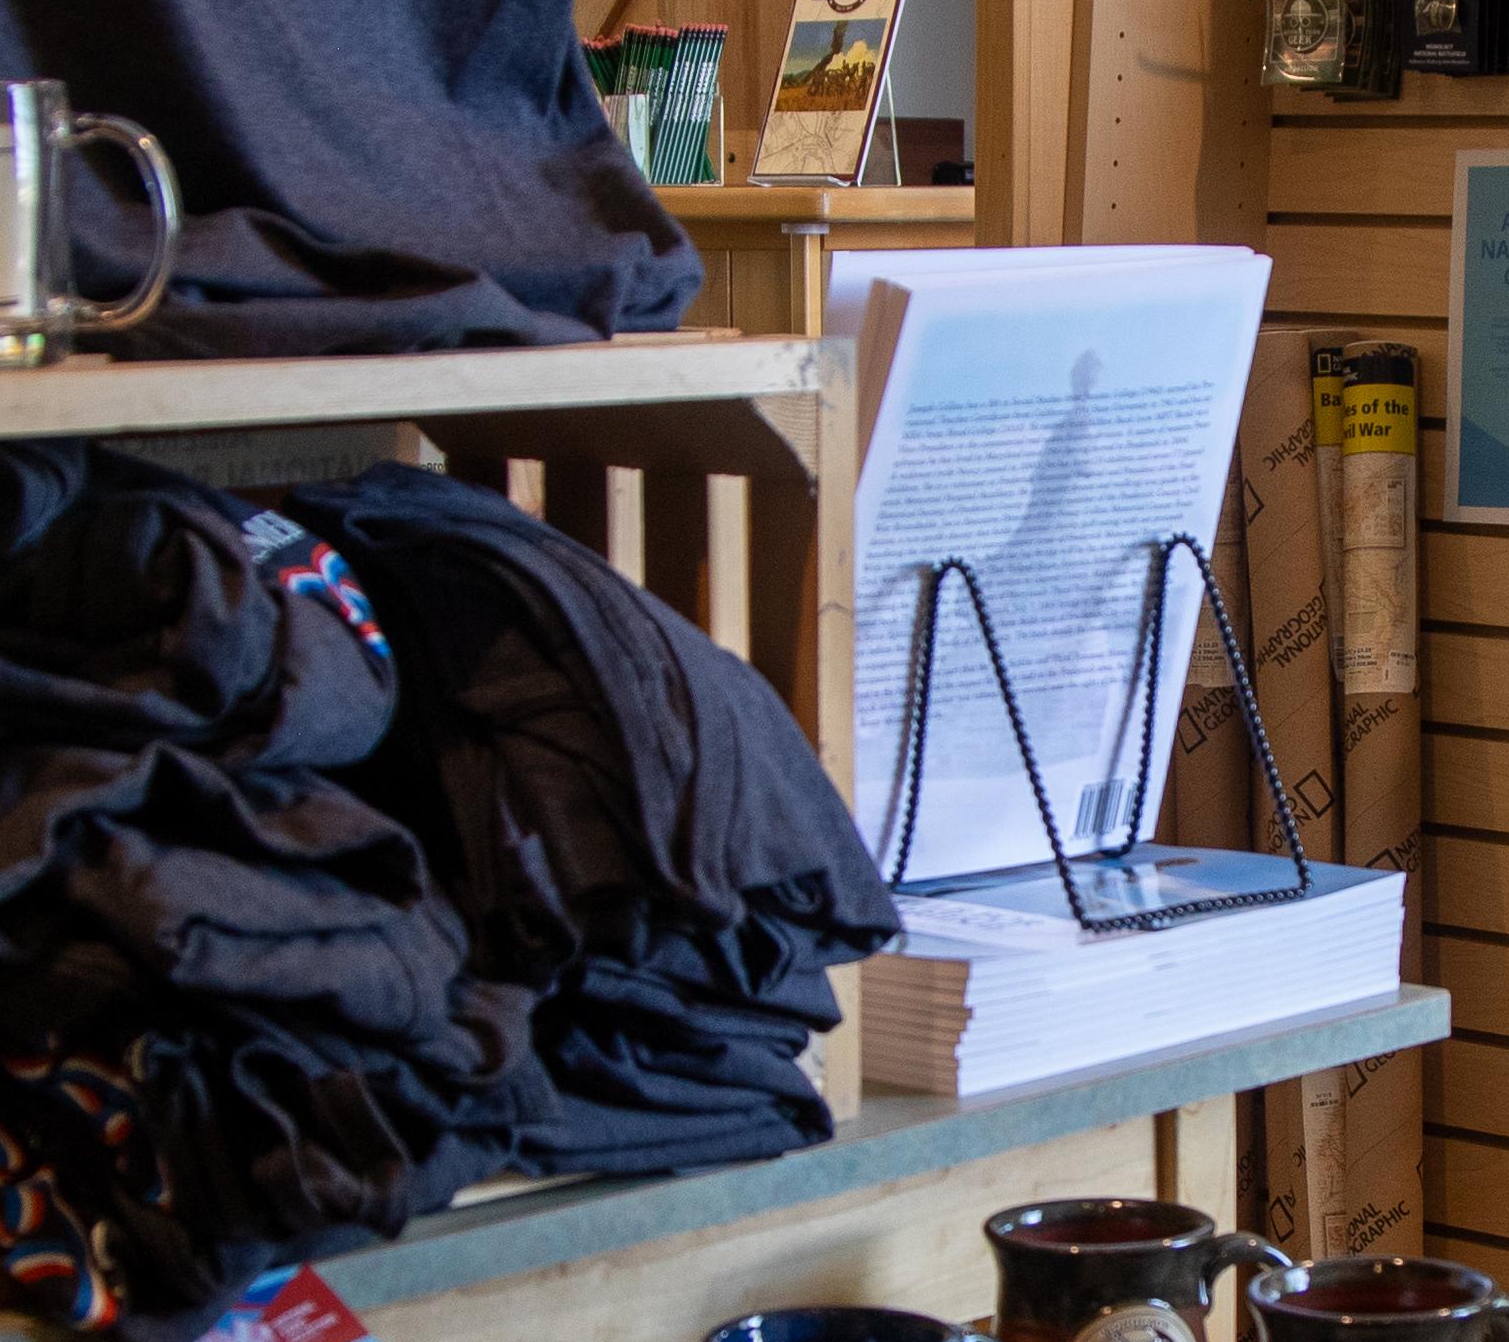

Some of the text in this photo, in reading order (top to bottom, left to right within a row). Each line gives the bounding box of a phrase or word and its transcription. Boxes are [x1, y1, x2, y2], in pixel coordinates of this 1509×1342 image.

[1361, 398, 1380, 415] of
[1384, 399, 1410, 416] the
[1359, 421, 1392, 438] War
[1344, 697, 1400, 755] GRAPHIC
